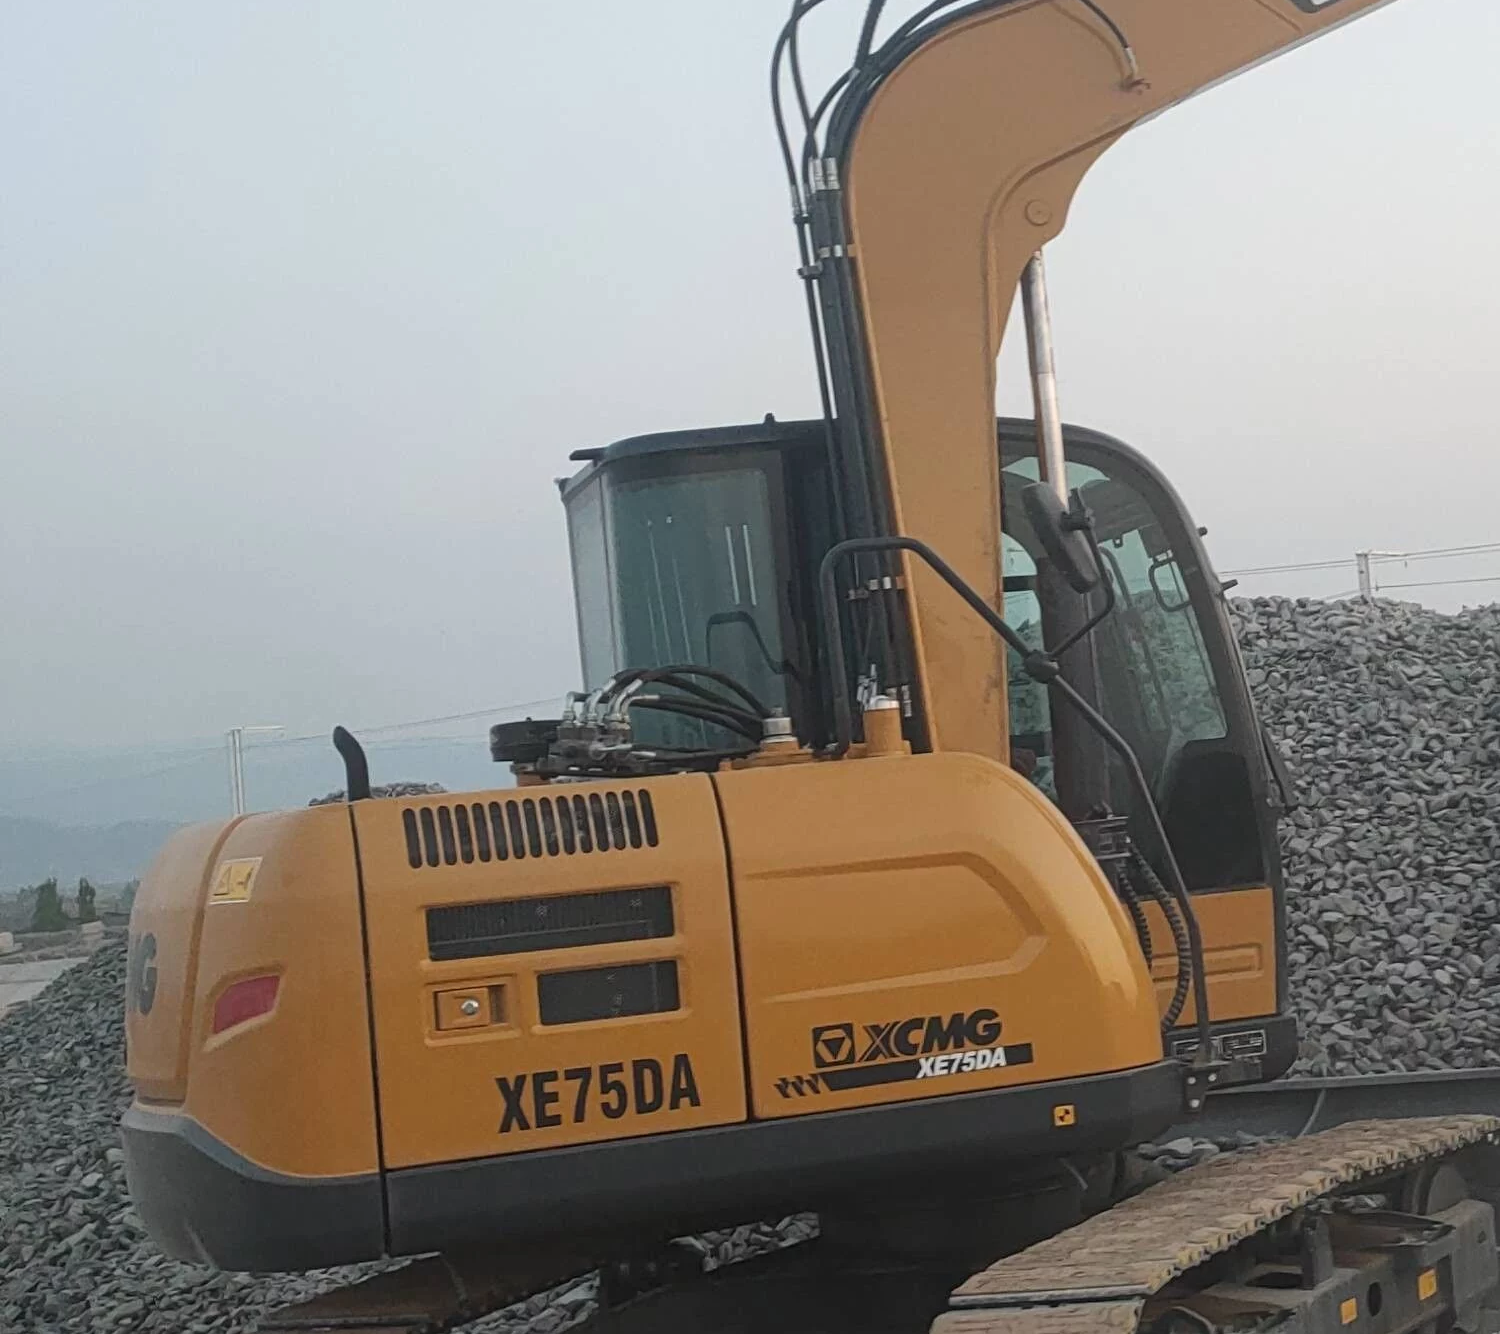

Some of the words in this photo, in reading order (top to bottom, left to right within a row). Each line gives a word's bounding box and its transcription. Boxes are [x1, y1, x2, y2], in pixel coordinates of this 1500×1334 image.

[858, 1008, 1003, 1063] XCMG
[915, 1046, 1007, 1080] XE75DA
[495, 1053, 701, 1133] XE75DA
